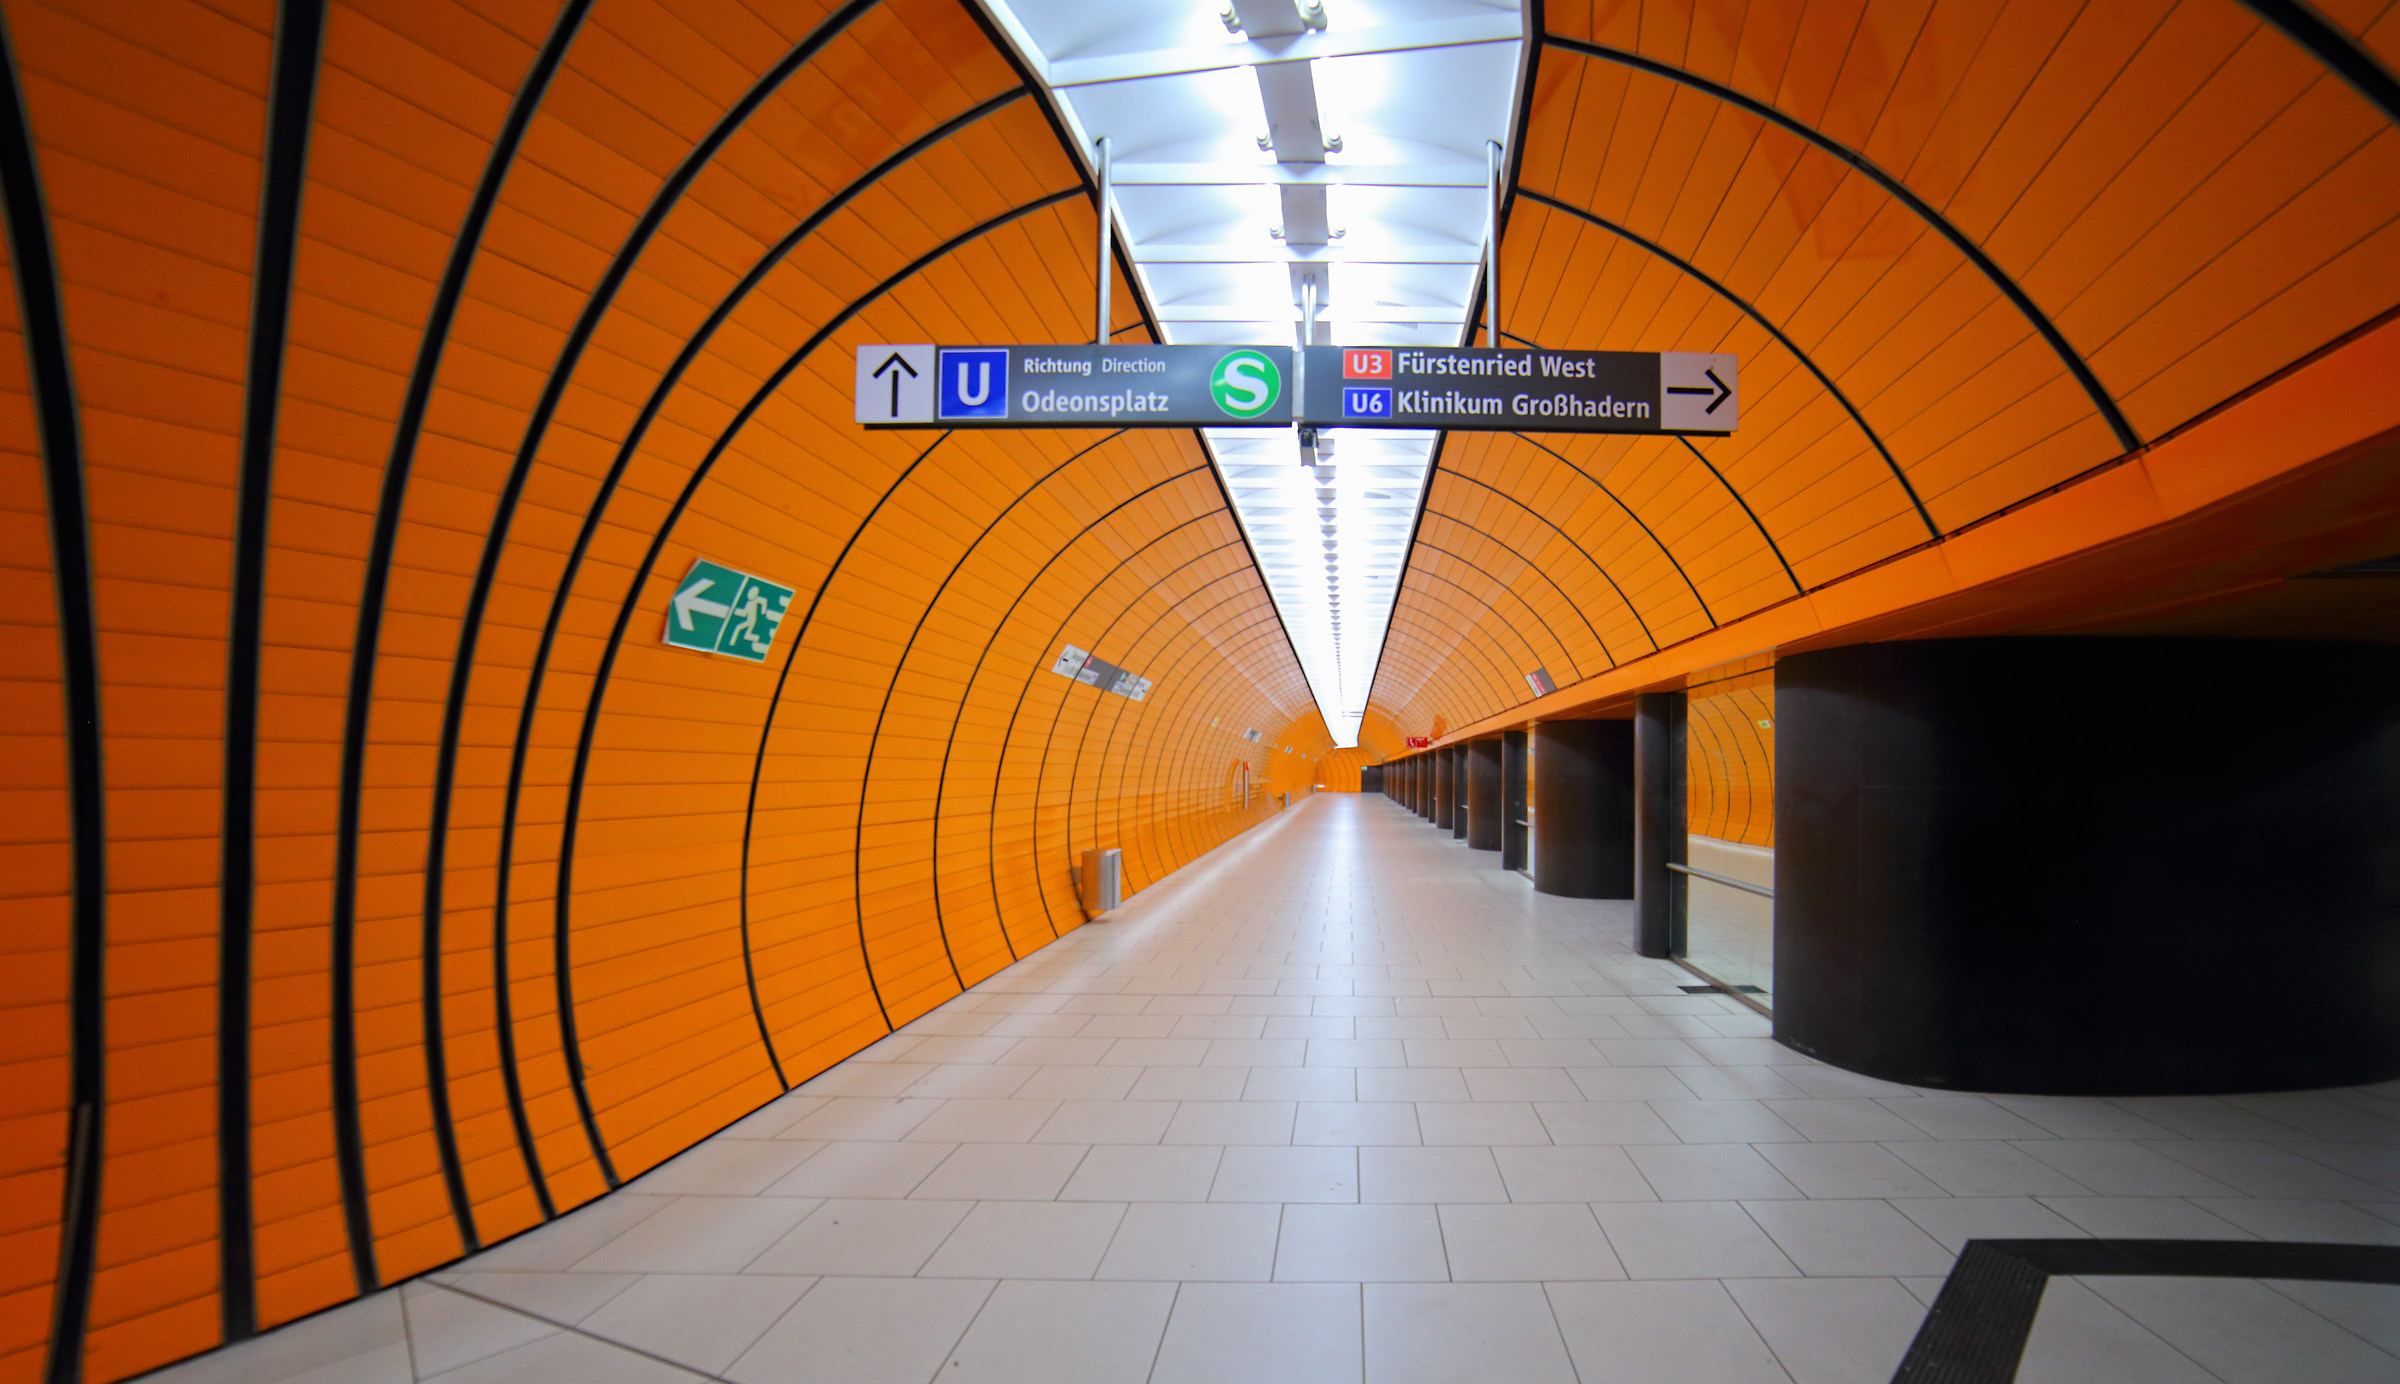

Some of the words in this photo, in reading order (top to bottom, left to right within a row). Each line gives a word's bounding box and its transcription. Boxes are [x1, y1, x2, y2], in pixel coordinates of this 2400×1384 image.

[1023, 357, 1092, 376] Richtung
[1102, 357, 1166, 374] Direction
[1353, 354, 1383, 374] U3
[1398, 352, 1532, 378] Fürstenried
[1539, 356, 1596, 379] West
[957, 361, 991, 406] U
[1224, 357, 1270, 411] S
[1022, 388, 1169, 417] Odeonsplatz
[1352, 392, 1383, 414] U6
[1398, 391, 1503, 415] Klinikum
[1511, 394, 1650, 419] Großhadern
